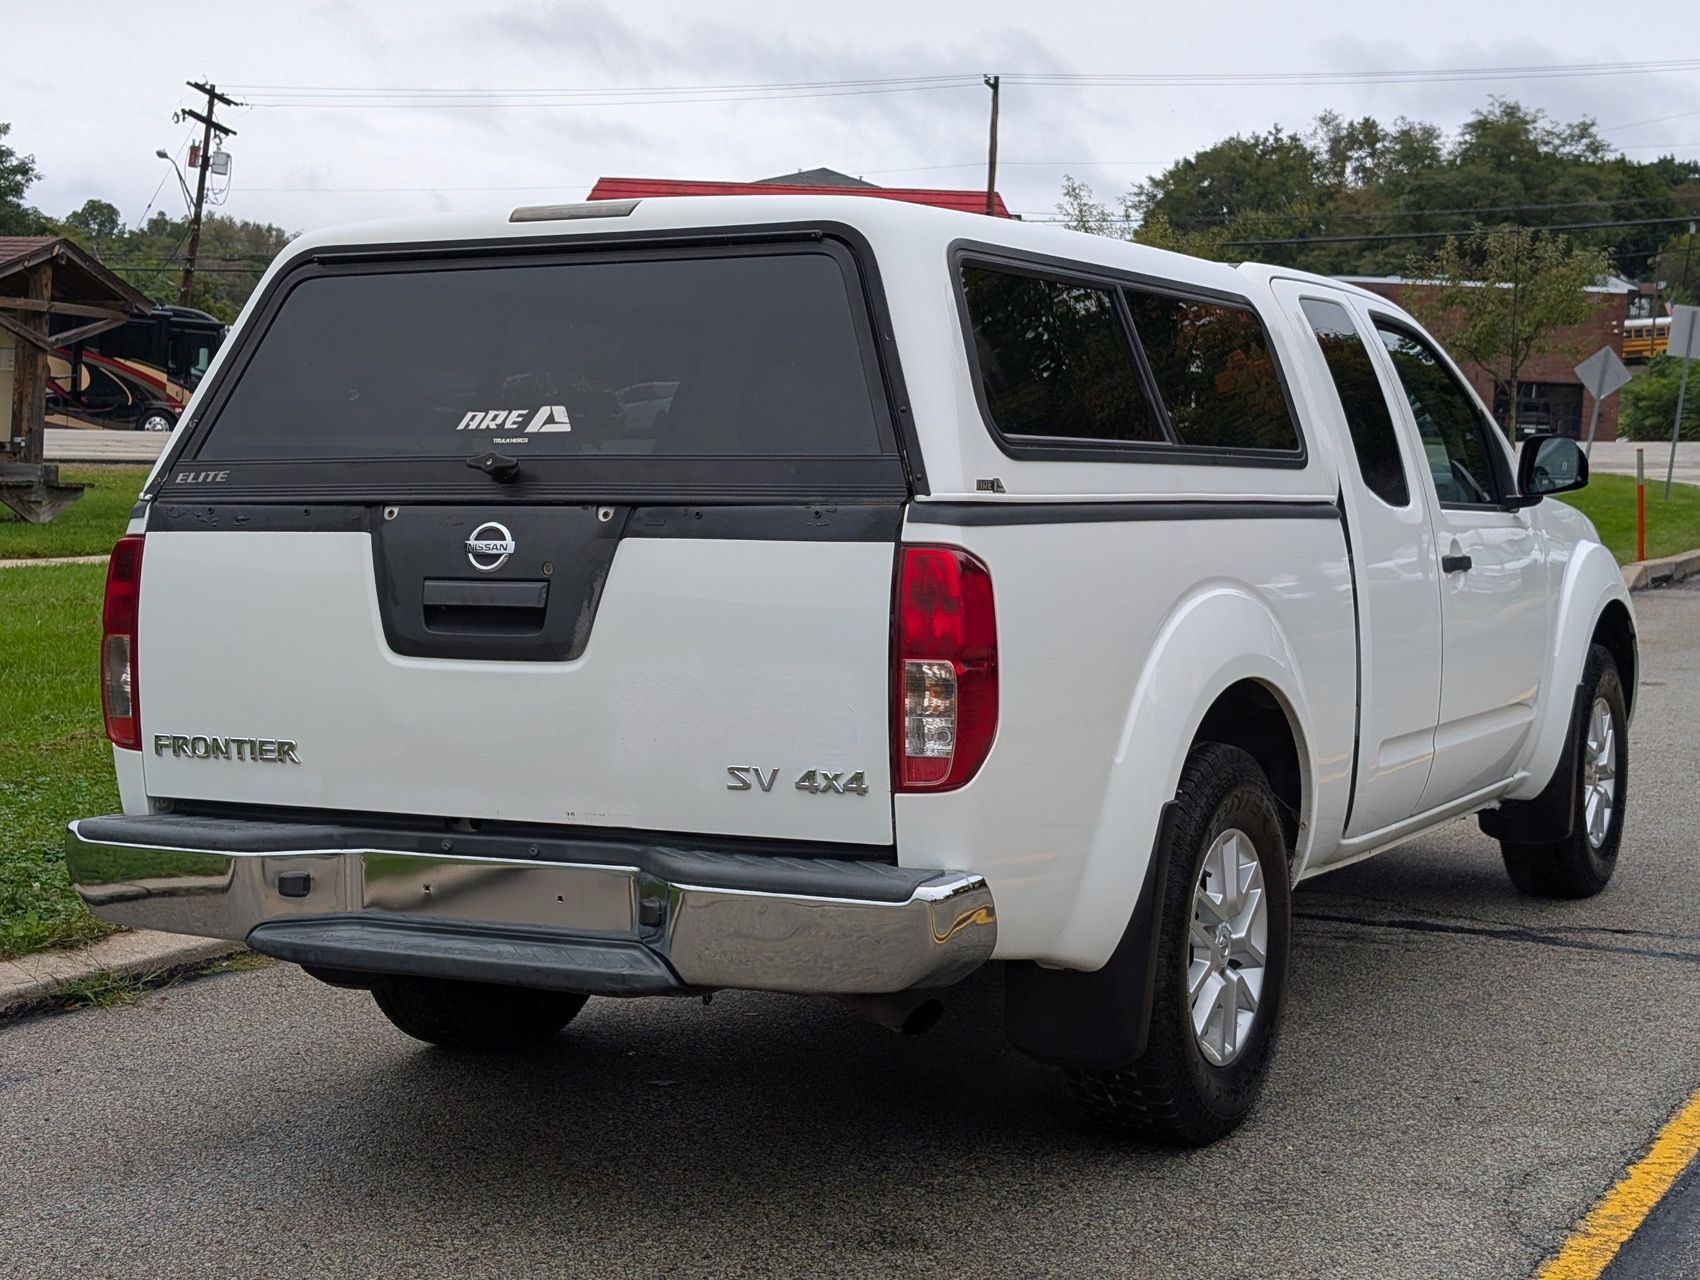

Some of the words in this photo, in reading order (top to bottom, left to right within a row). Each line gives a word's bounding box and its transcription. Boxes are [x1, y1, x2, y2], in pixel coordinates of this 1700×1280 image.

[175, 470, 231, 484] ELITE
[466, 543, 509, 552] NISSAN
[154, 733, 301, 763] FRONTIER
[726, 765, 780, 792] SV
